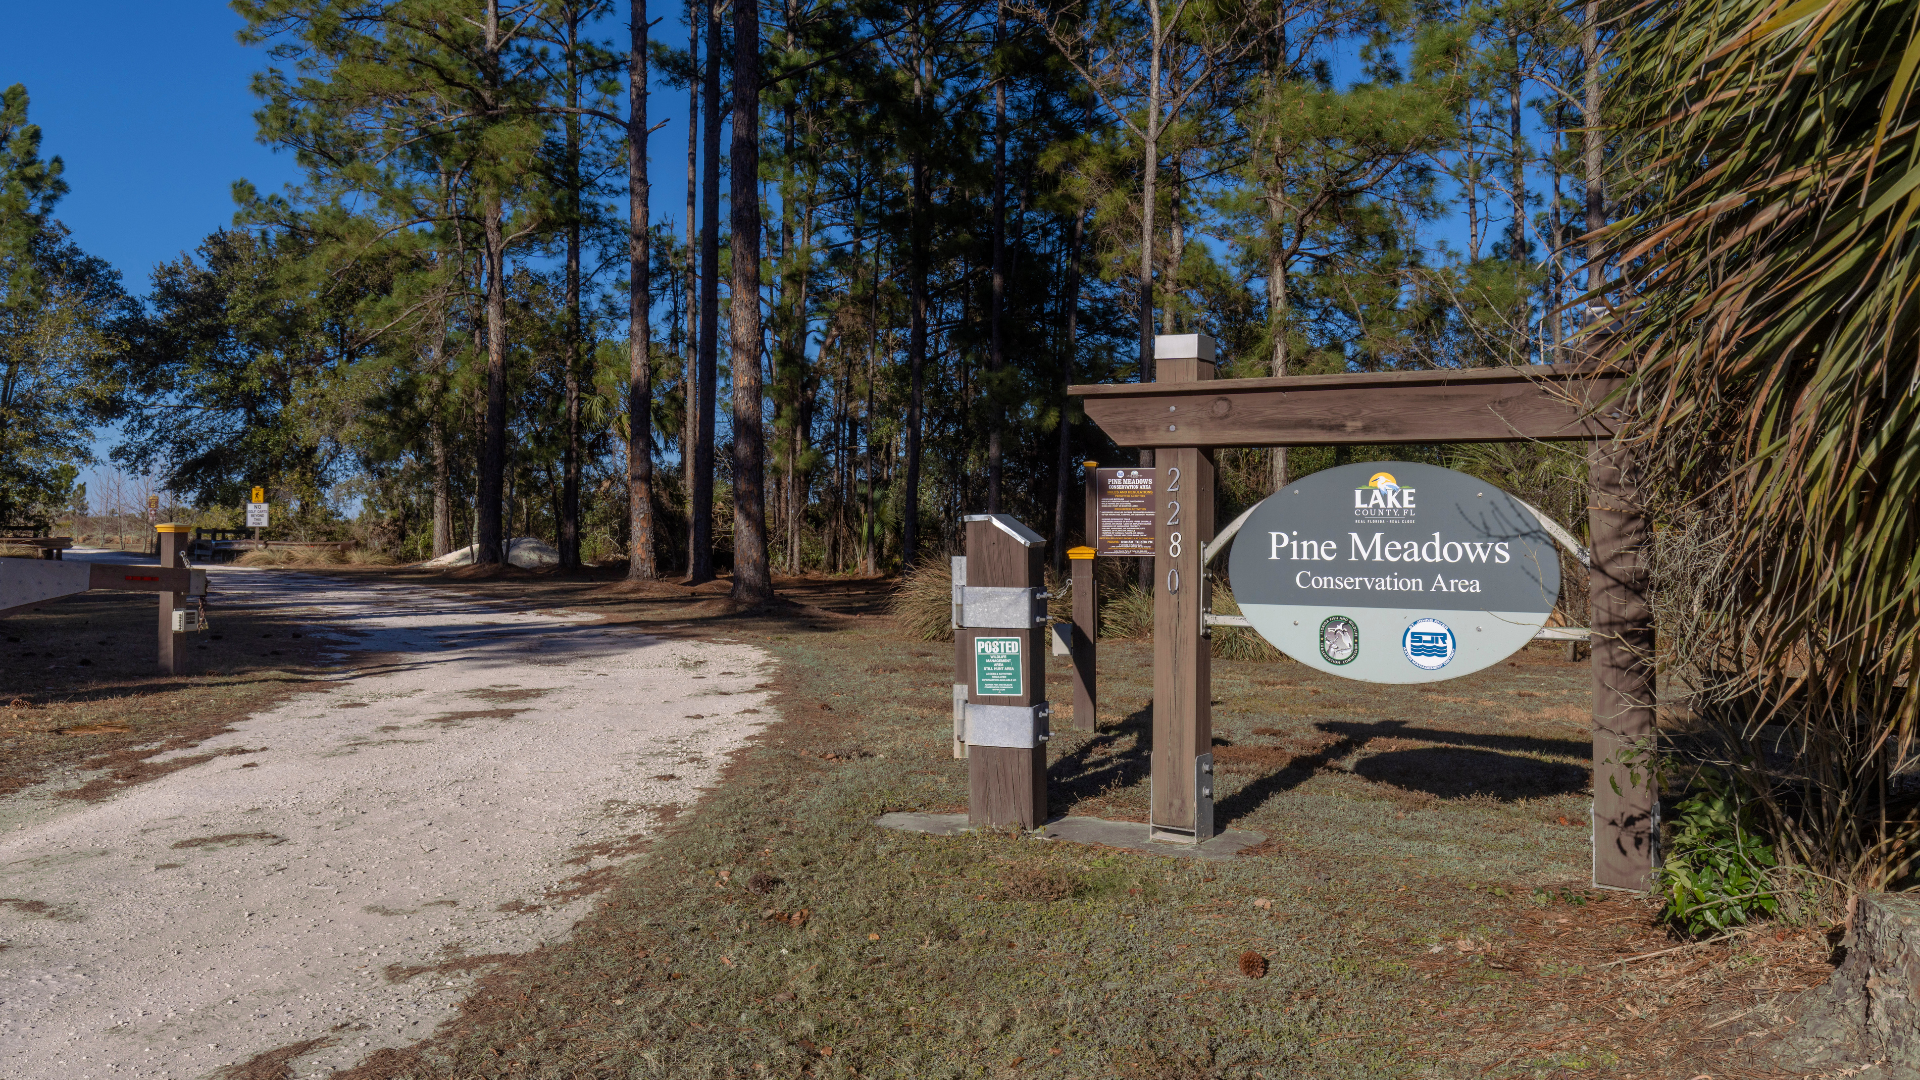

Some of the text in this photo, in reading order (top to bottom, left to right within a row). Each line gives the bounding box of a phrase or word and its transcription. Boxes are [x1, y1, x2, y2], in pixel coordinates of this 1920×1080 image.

[1354, 488, 1416, 509] LAKE
[1354, 509, 1400, 517] COUNTY,
[1167, 467, 1182, 595] 2280
[1267, 530, 1511, 564] Pine Meadows
[1295, 570, 1481, 593] Conservation Area
[978, 641, 1018, 653] POSTED
